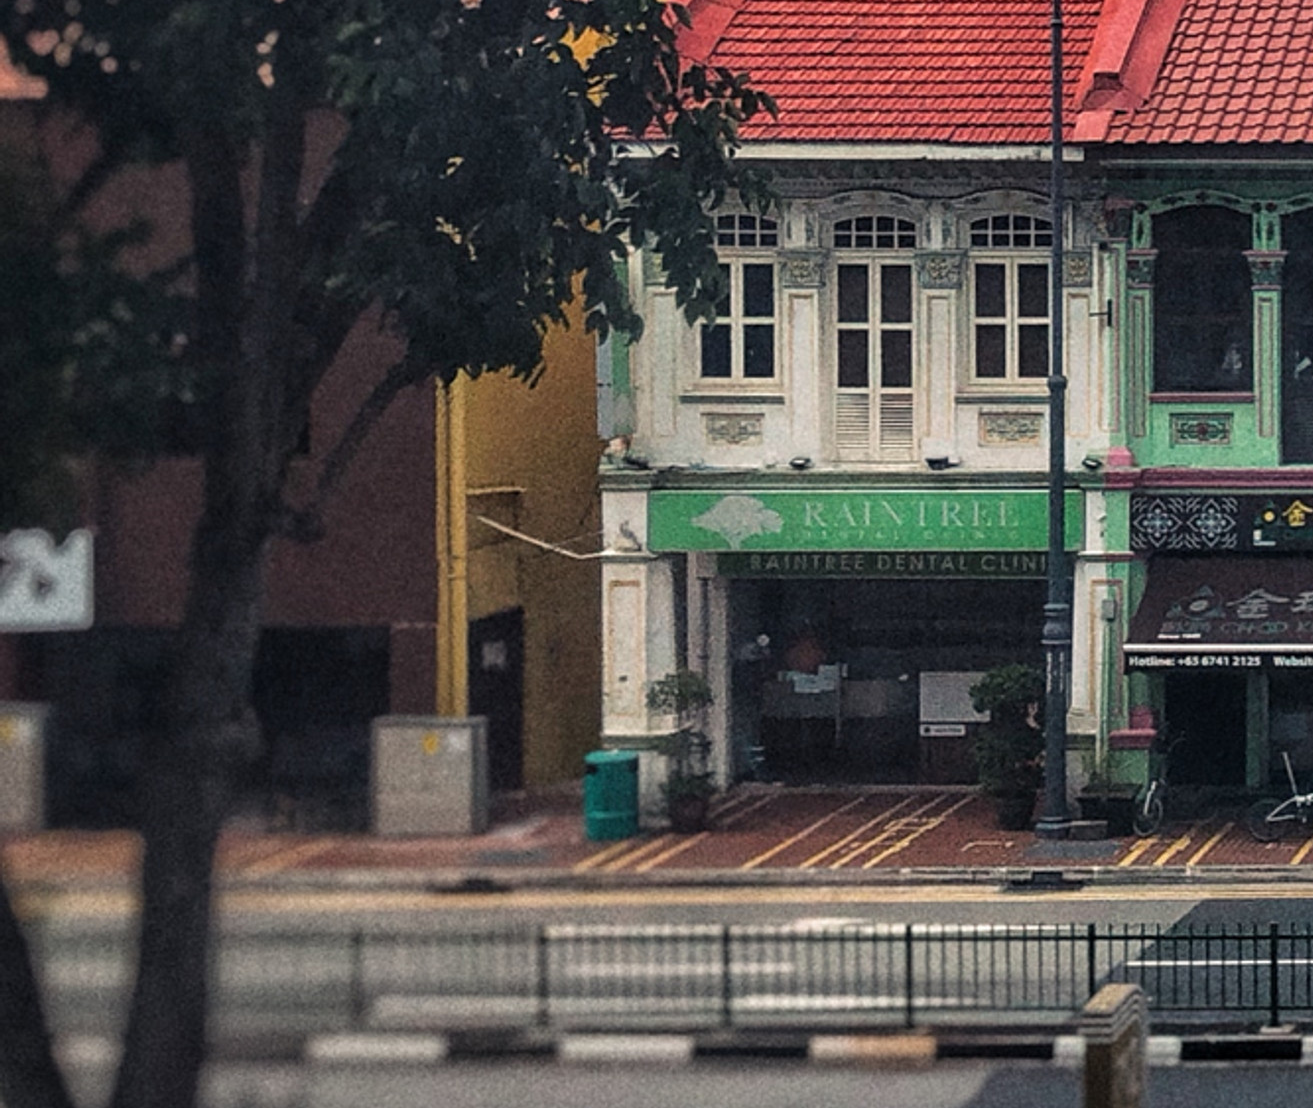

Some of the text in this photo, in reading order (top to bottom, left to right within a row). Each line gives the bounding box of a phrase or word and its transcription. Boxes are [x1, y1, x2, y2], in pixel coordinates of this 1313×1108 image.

[804, 501, 1019, 527] RAINTREE
[750, 554, 1047, 572] RAINTREE DENTAL CLINI
[1128, 655, 1175, 666] Hotline:
[1177, 655, 1199, 666] +65
[1201, 655, 1230, 666] 6741
[1231, 655, 1261, 666] 2125
